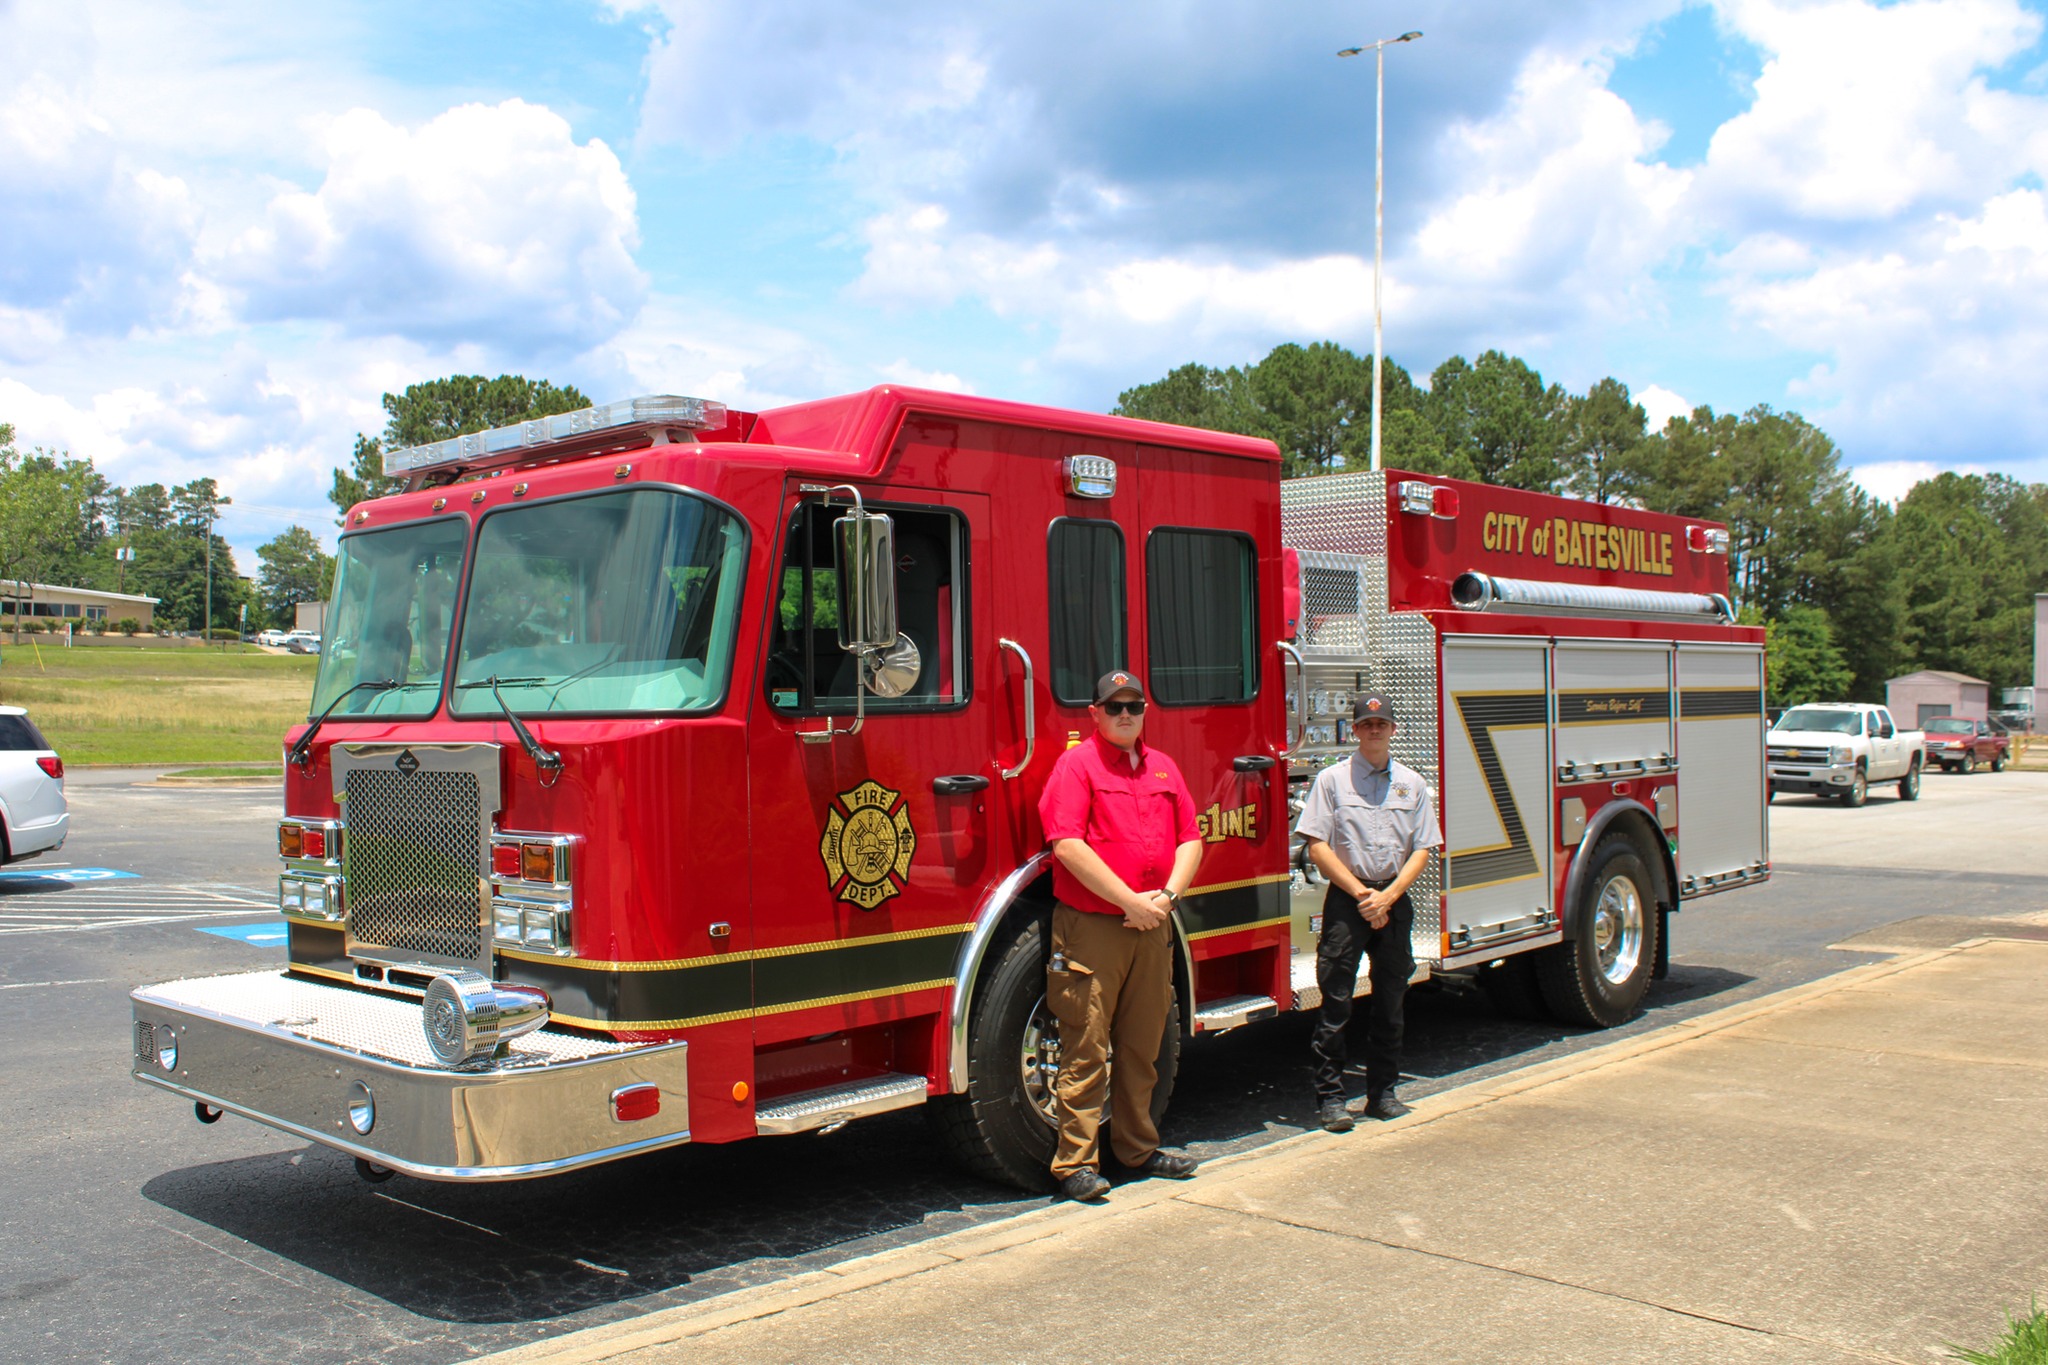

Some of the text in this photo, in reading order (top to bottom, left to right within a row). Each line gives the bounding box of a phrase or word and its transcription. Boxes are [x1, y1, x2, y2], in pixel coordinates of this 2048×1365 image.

[1482, 511, 1674, 575] CITY of BATESVILLE
[854, 789, 888, 805] FIRE
[848, 883, 892, 902] DEPT.
